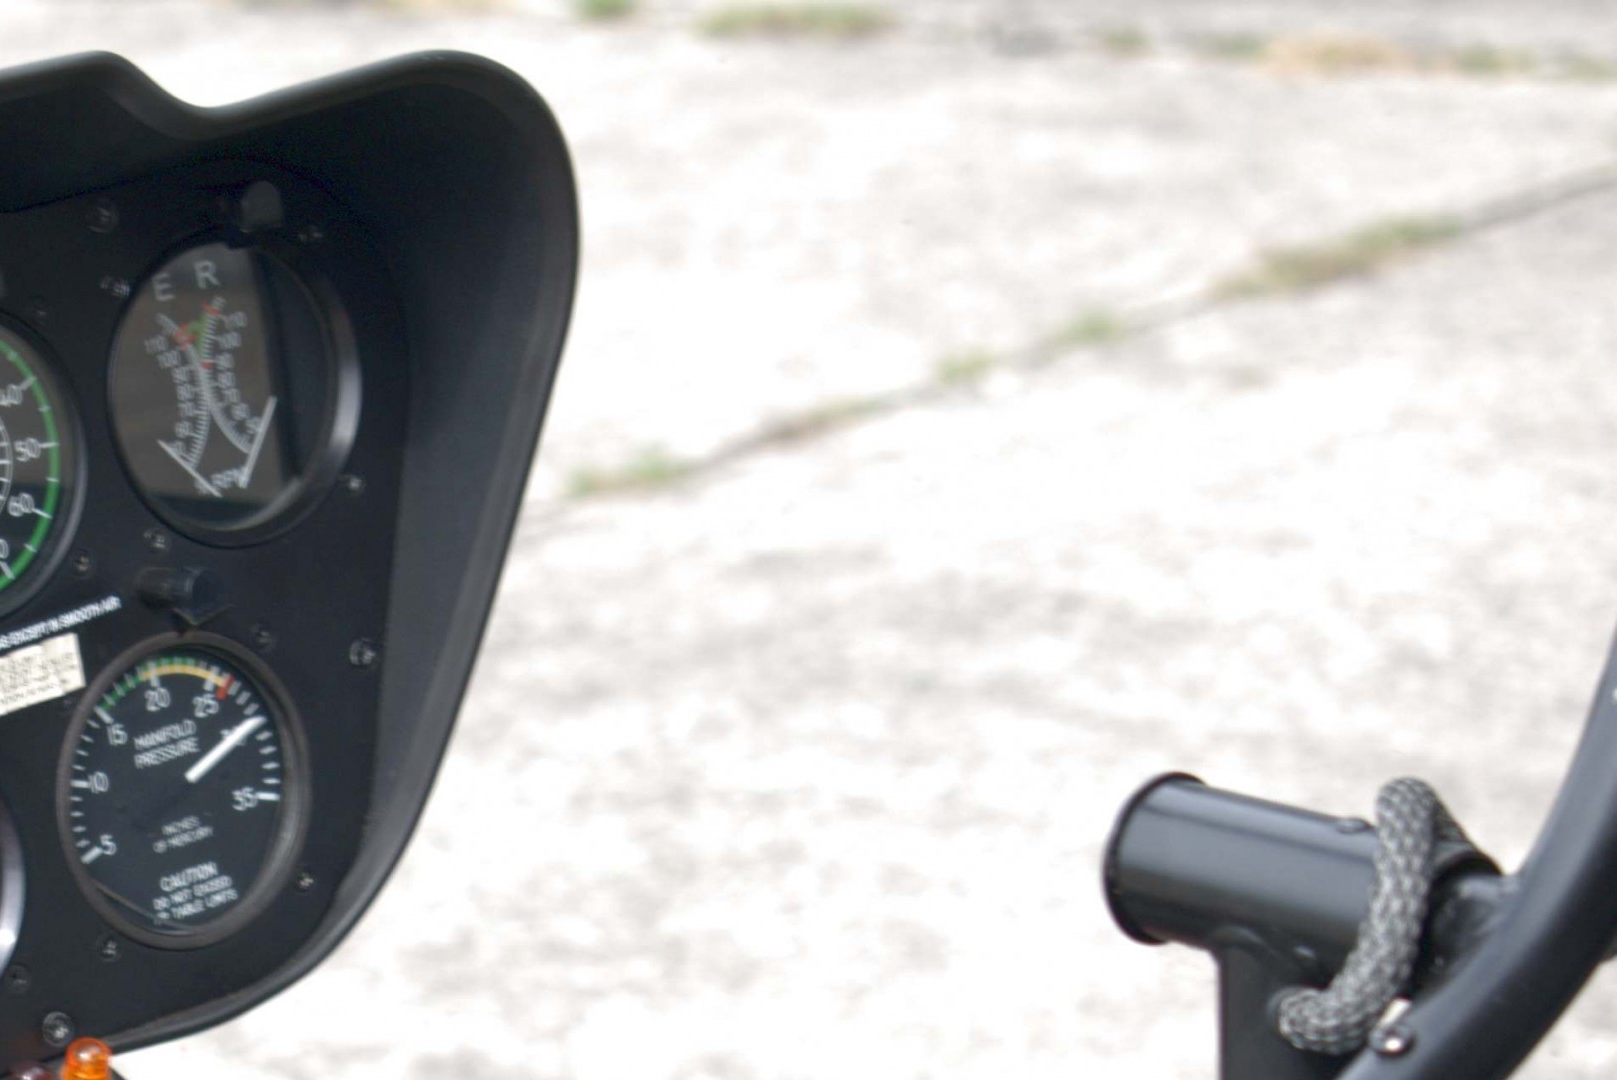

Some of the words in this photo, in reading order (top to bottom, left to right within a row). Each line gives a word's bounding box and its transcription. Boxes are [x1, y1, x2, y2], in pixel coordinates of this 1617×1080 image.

[152, 272, 175, 301] E
[194, 260, 220, 289] R
[14, 438, 42, 462] 50
[7, 493, 35, 518] 60
[58, 604, 100, 628] SMOOTH
[145, 688, 171, 712] 20
[192, 694, 219, 718] 25
[107, 723, 128, 746] 15
[134, 719, 197, 750] MANIFOLD
[134, 737, 199, 769] PRESSURE
[88, 772, 110, 794] 10
[232, 787, 257, 811] 35
[100, 834, 117, 855] 5
[160, 861, 218, 892] CAUTION
